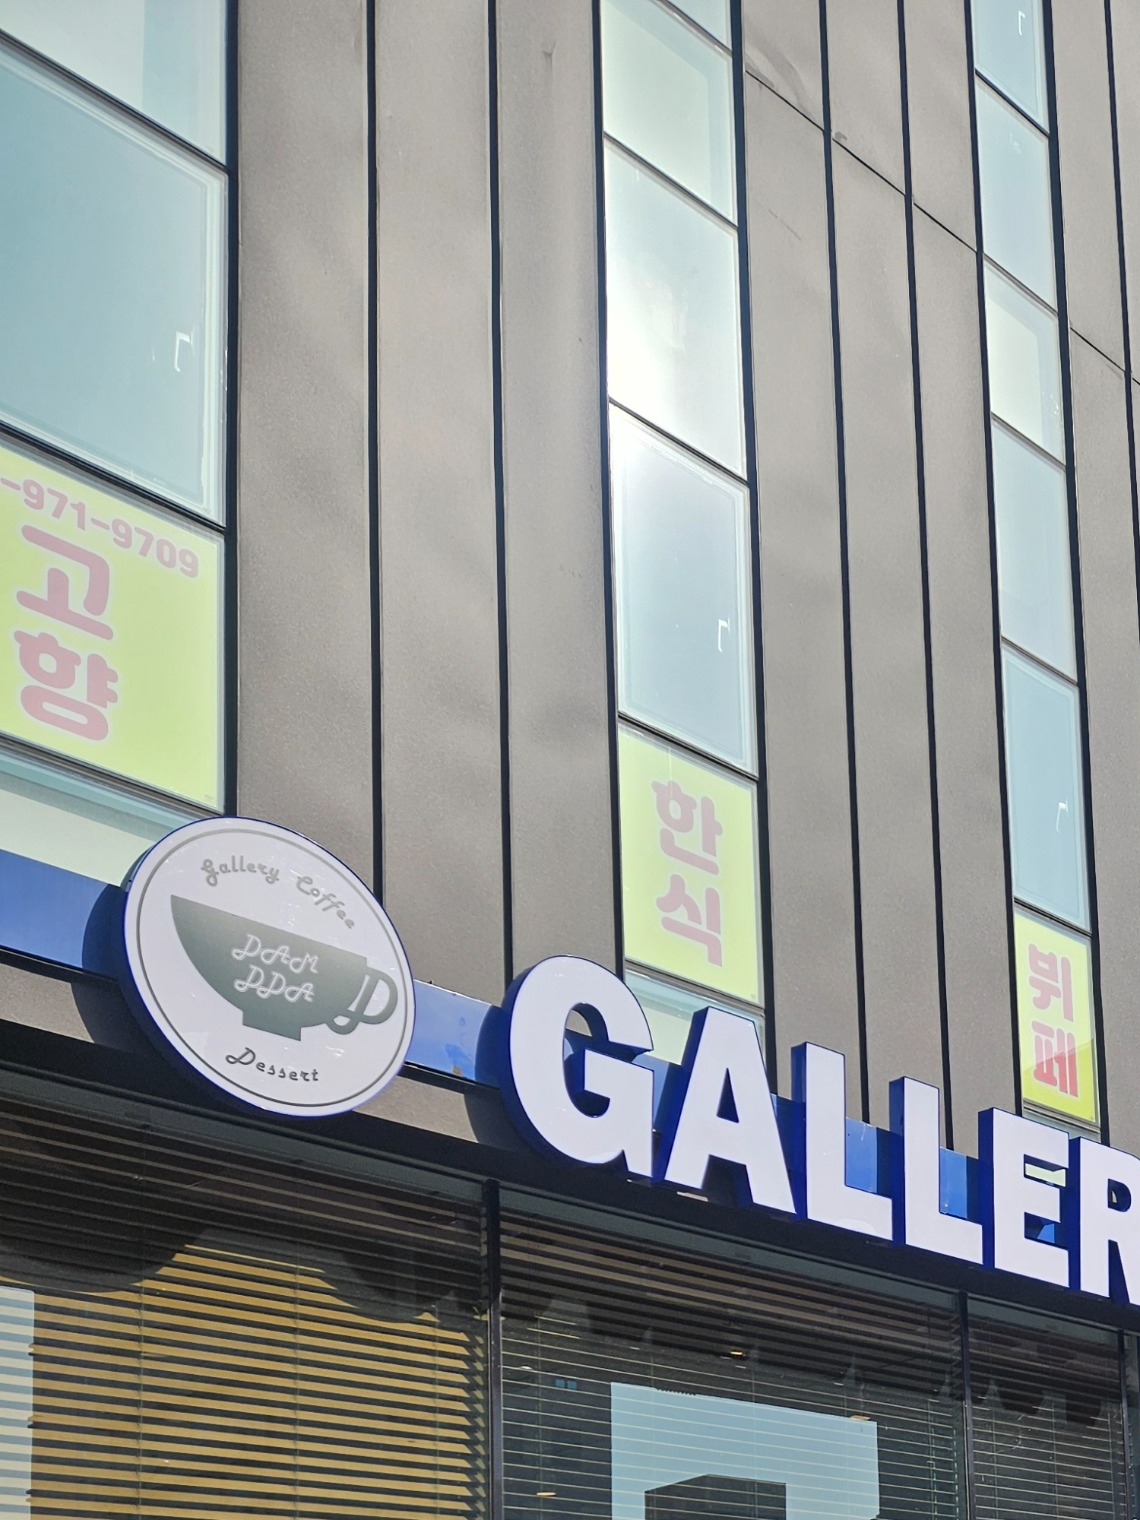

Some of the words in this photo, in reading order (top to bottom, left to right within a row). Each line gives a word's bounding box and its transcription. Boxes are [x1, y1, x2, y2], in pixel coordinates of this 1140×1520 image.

[13, 524, 119, 741] 고향
[201, 855, 280, 887] Gallery
[296, 876, 355, 929] Coffee
[651, 780, 723, 967] 한식
[233, 966, 315, 1002] DDA
[1028, 943, 1079, 1098] 뷔페
[225, 1047, 319, 1081] Dessert
